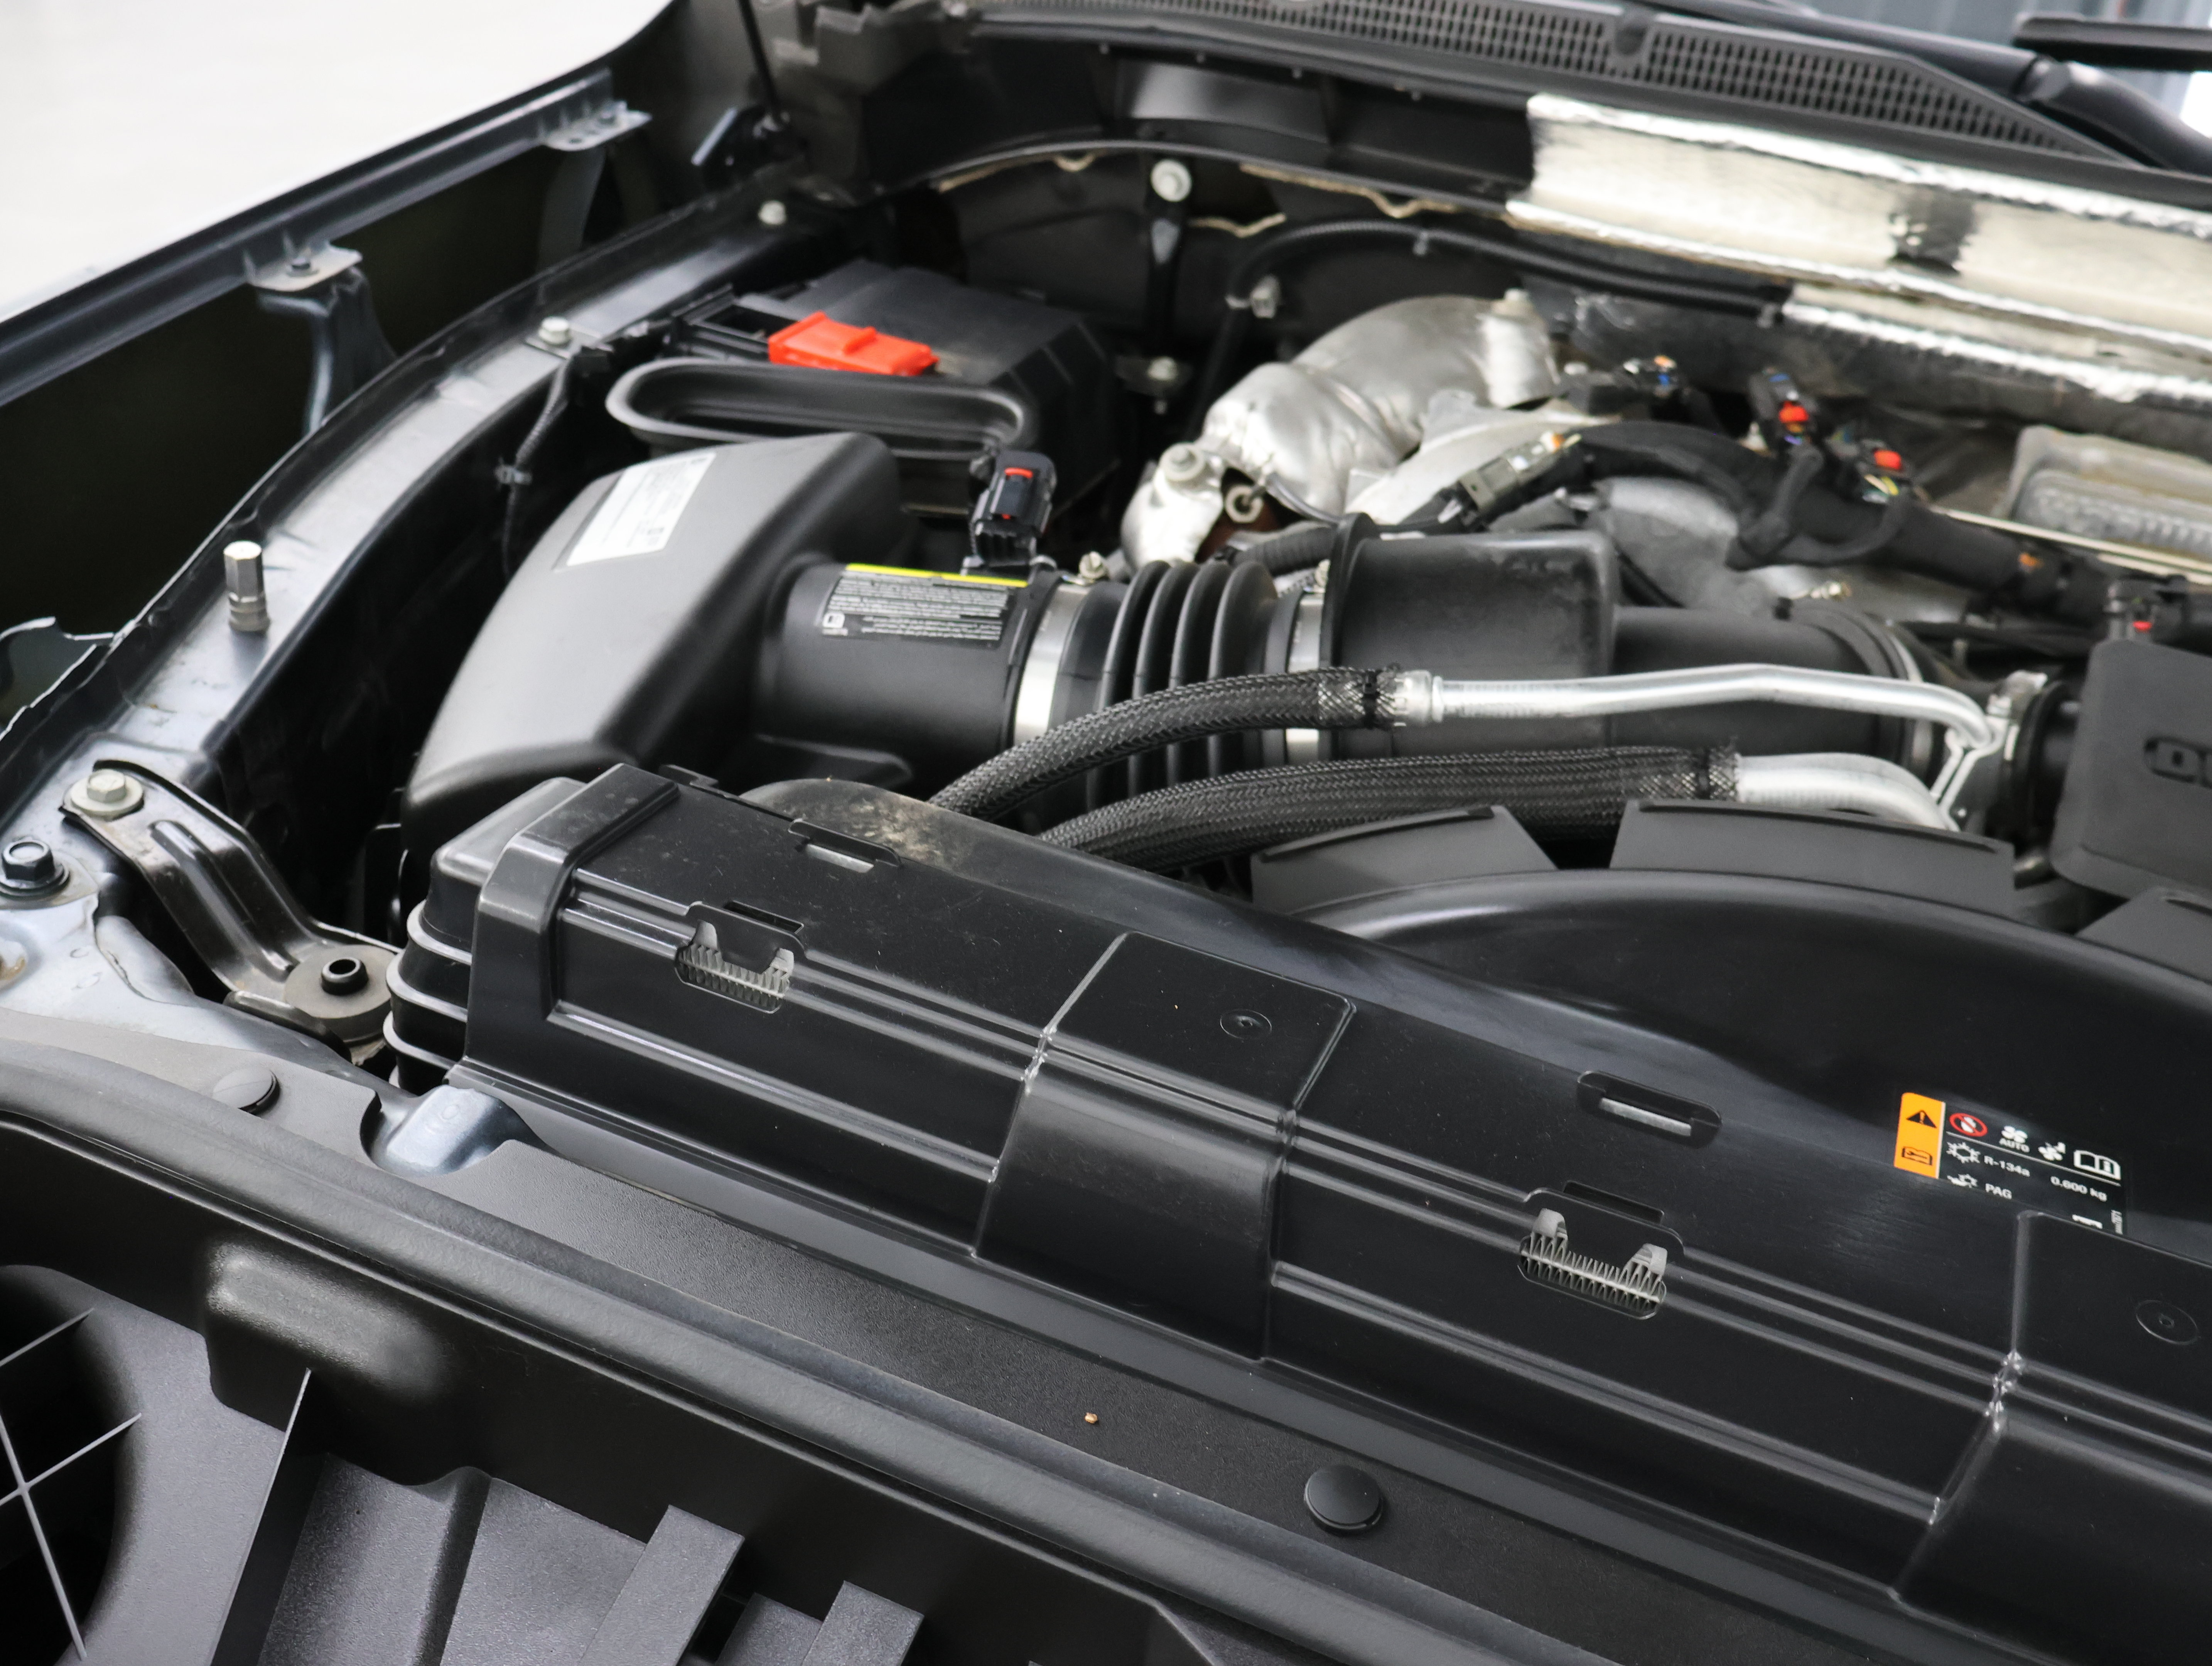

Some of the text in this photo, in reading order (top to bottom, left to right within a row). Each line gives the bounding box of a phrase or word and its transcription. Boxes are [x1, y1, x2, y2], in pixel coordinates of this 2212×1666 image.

[1999, 1138, 2030, 1153] AUTO
[1984, 1155, 2030, 1177] R-134a
[1985, 1184, 2012, 1200] PAG
[2090, 1187, 2107, 1202] kg
